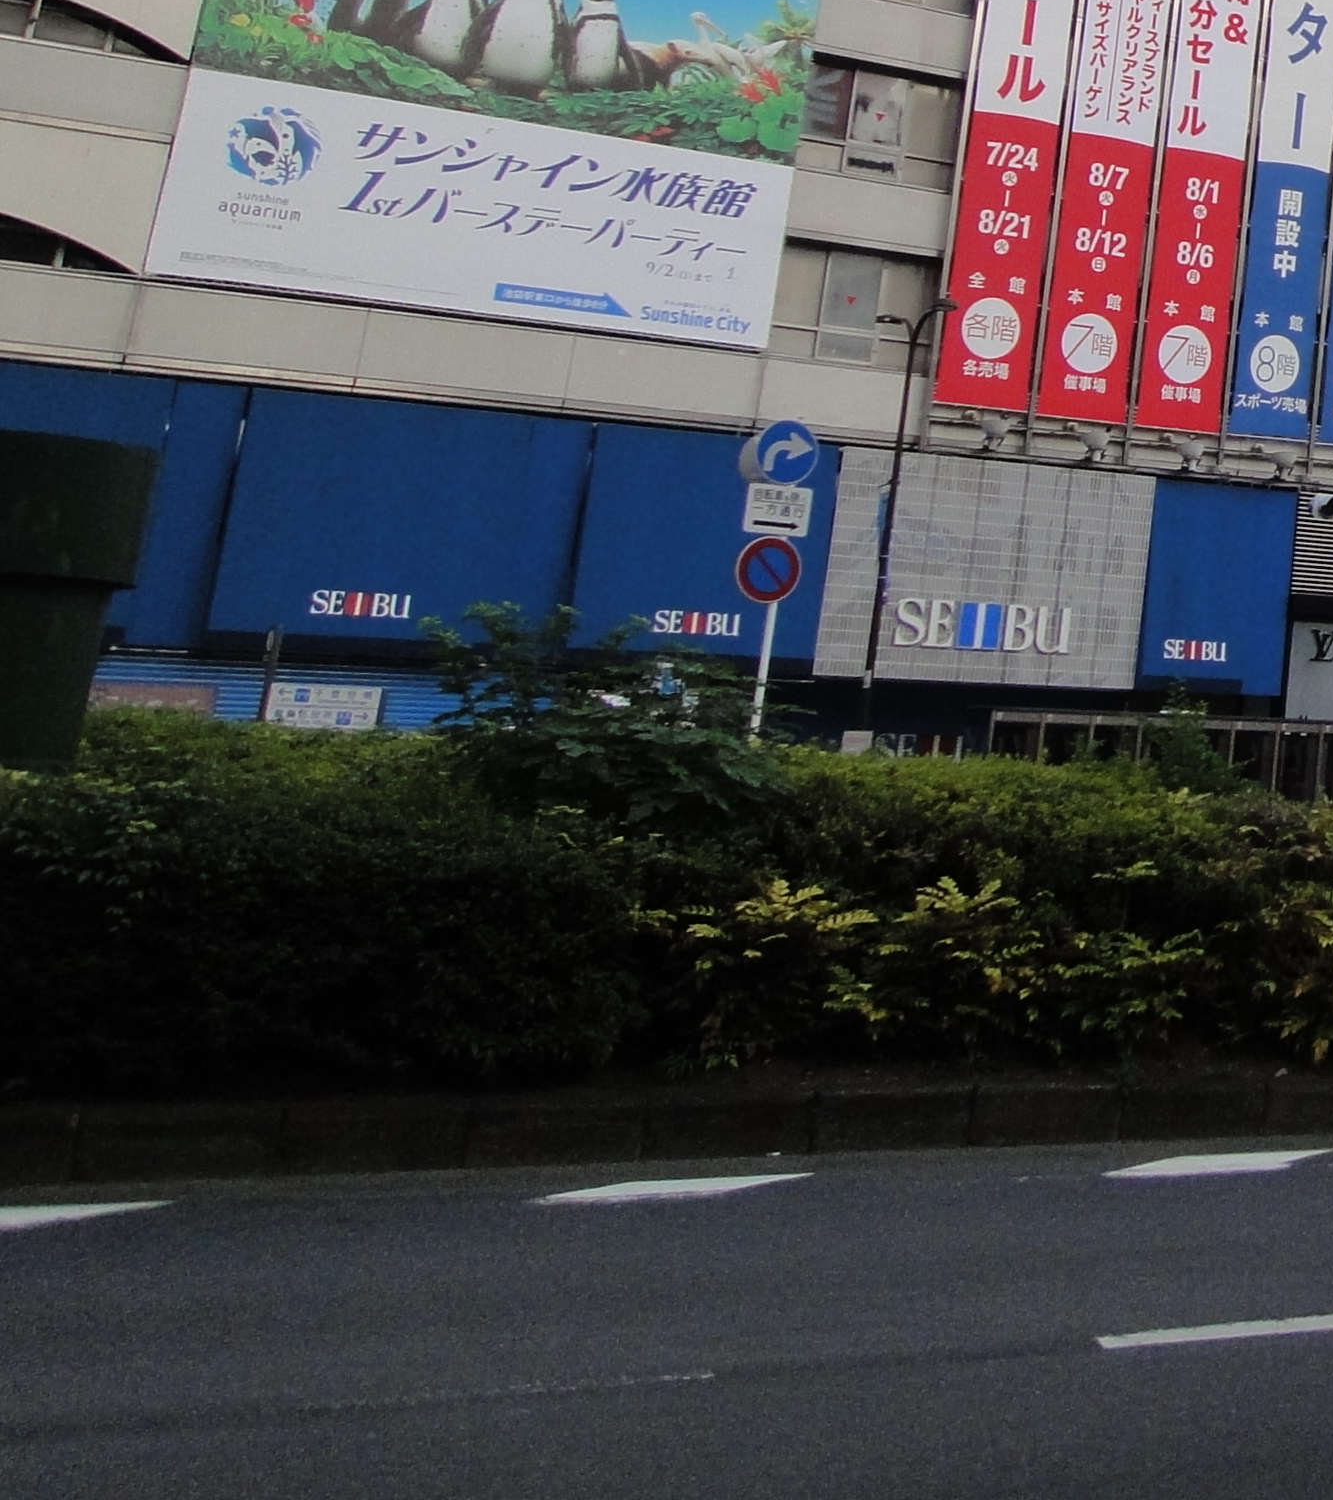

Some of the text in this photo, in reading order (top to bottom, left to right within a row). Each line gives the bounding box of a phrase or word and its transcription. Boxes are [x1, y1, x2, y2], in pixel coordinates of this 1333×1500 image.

[353, 121, 757, 219] サンシャイン水族館
[986, 140, 1039, 172] 7/24
[1089, 163, 1129, 189] 8/7
[236, 190, 290, 206] sunshine
[1186, 178, 1220, 204] 8/1
[218, 200, 301, 222] aquarium
[978, 210, 1031, 240] 8/21
[1075, 228, 1126, 258] 8/12
[1273, 189, 1304, 278] 開設中
[1177, 242, 1213, 268] 8/6
[1067, 288, 1122, 311] 本館
[1163, 301, 1215, 321] 本館
[640, 305, 713, 329] Sunshine
[715, 313, 751, 335] City
[964, 311, 1019, 344] 各階
[1254, 312, 1304, 332] 本館
[1062, 323, 1112, 359] 7階
[1160, 335, 1208, 370] 7階
[962, 359, 1010, 381] 各売場
[1256, 346, 1296, 382] 8階
[1235, 392, 1306, 415] スポーツ売場
[309, 588, 411, 620] SEIBU
[652, 609, 741, 638] SEIBU
[892, 598, 1071, 656] SEIBU
[1162, 638, 1227, 663] SEIBU
